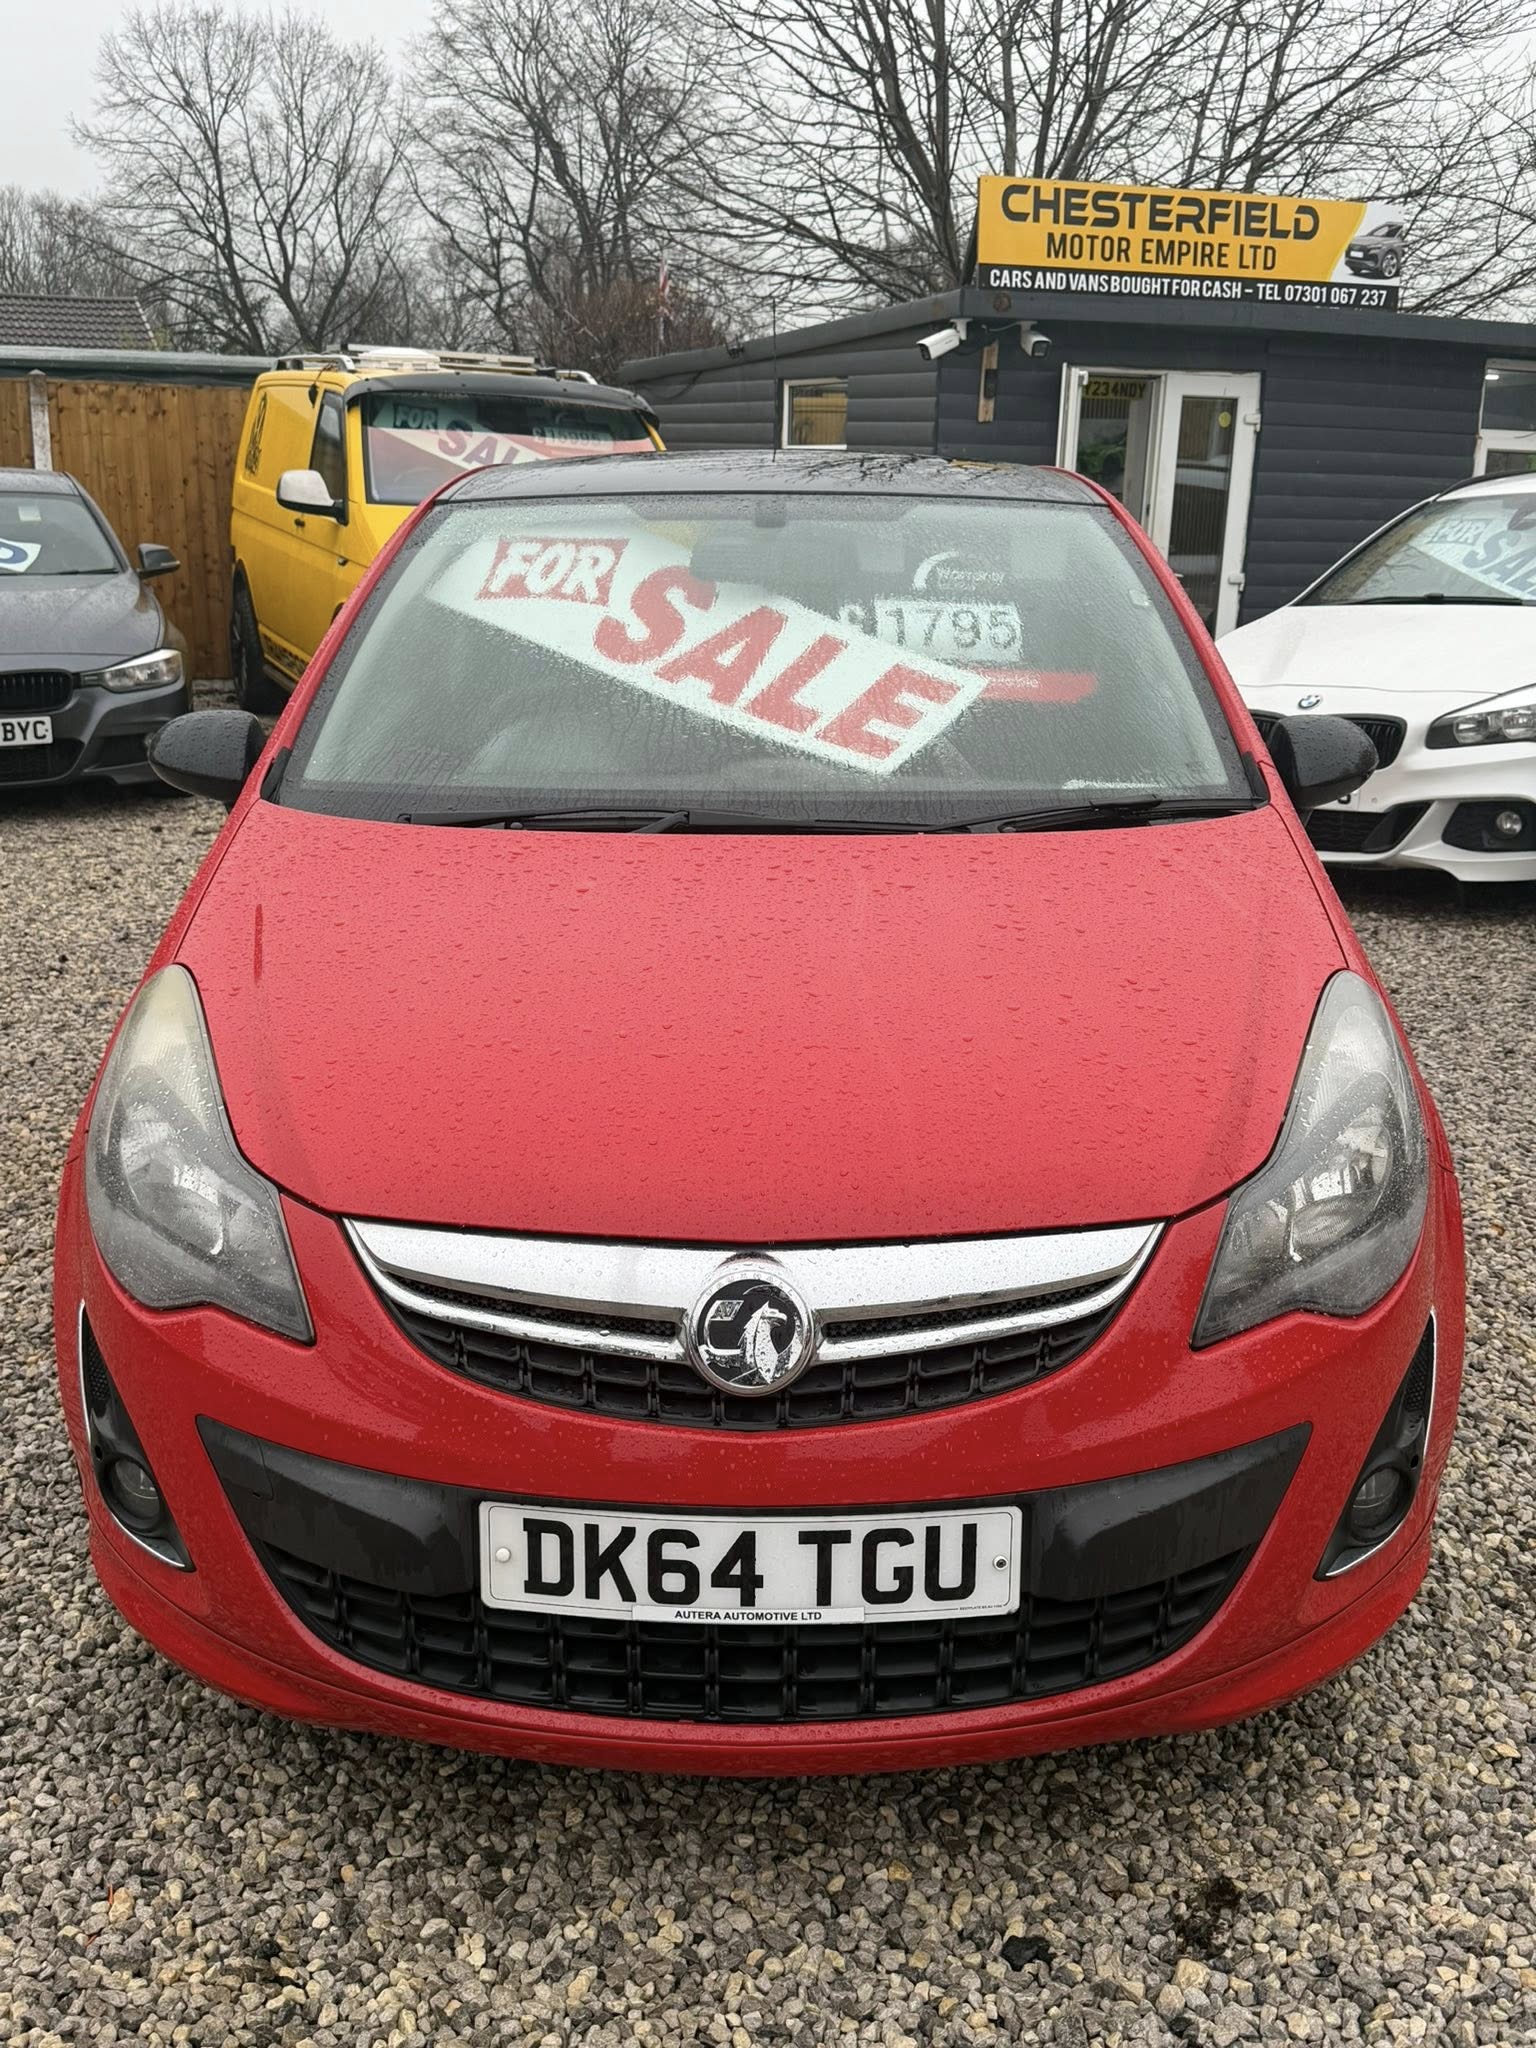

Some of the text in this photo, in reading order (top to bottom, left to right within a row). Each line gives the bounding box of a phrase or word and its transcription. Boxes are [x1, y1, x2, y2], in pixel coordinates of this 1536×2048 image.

[1001, 184, 1320, 241] CHESTERFIELD
[1046, 231, 1277, 271] MOTOR EMPIRE LTD
[989, 269, 1033, 288] CARS
[1034, 271, 1067, 291] AND
[1068, 273, 1109, 293] VANS
[1111, 275, 1171, 296] BOUGHT
[1172, 279, 1201, 297] FOR
[1202, 280, 1242, 299] CASH
[1256, 283, 1282, 302] TEL
[1284, 284, 1327, 303] 07301
[1331, 287, 1358, 305] 067
[1360, 289, 1388, 307] 237
[395, 403, 519, 465] FOR SAL
[1430, 519, 1490, 546] FOR
[494, 540, 962, 759] FOR SALE
[1, 720, 46, 742] BYC
[522, 1517, 978, 1607] DK64 TGU
[674, 1610, 822, 1621] AUTERA AUTOMOTIVE LTD
